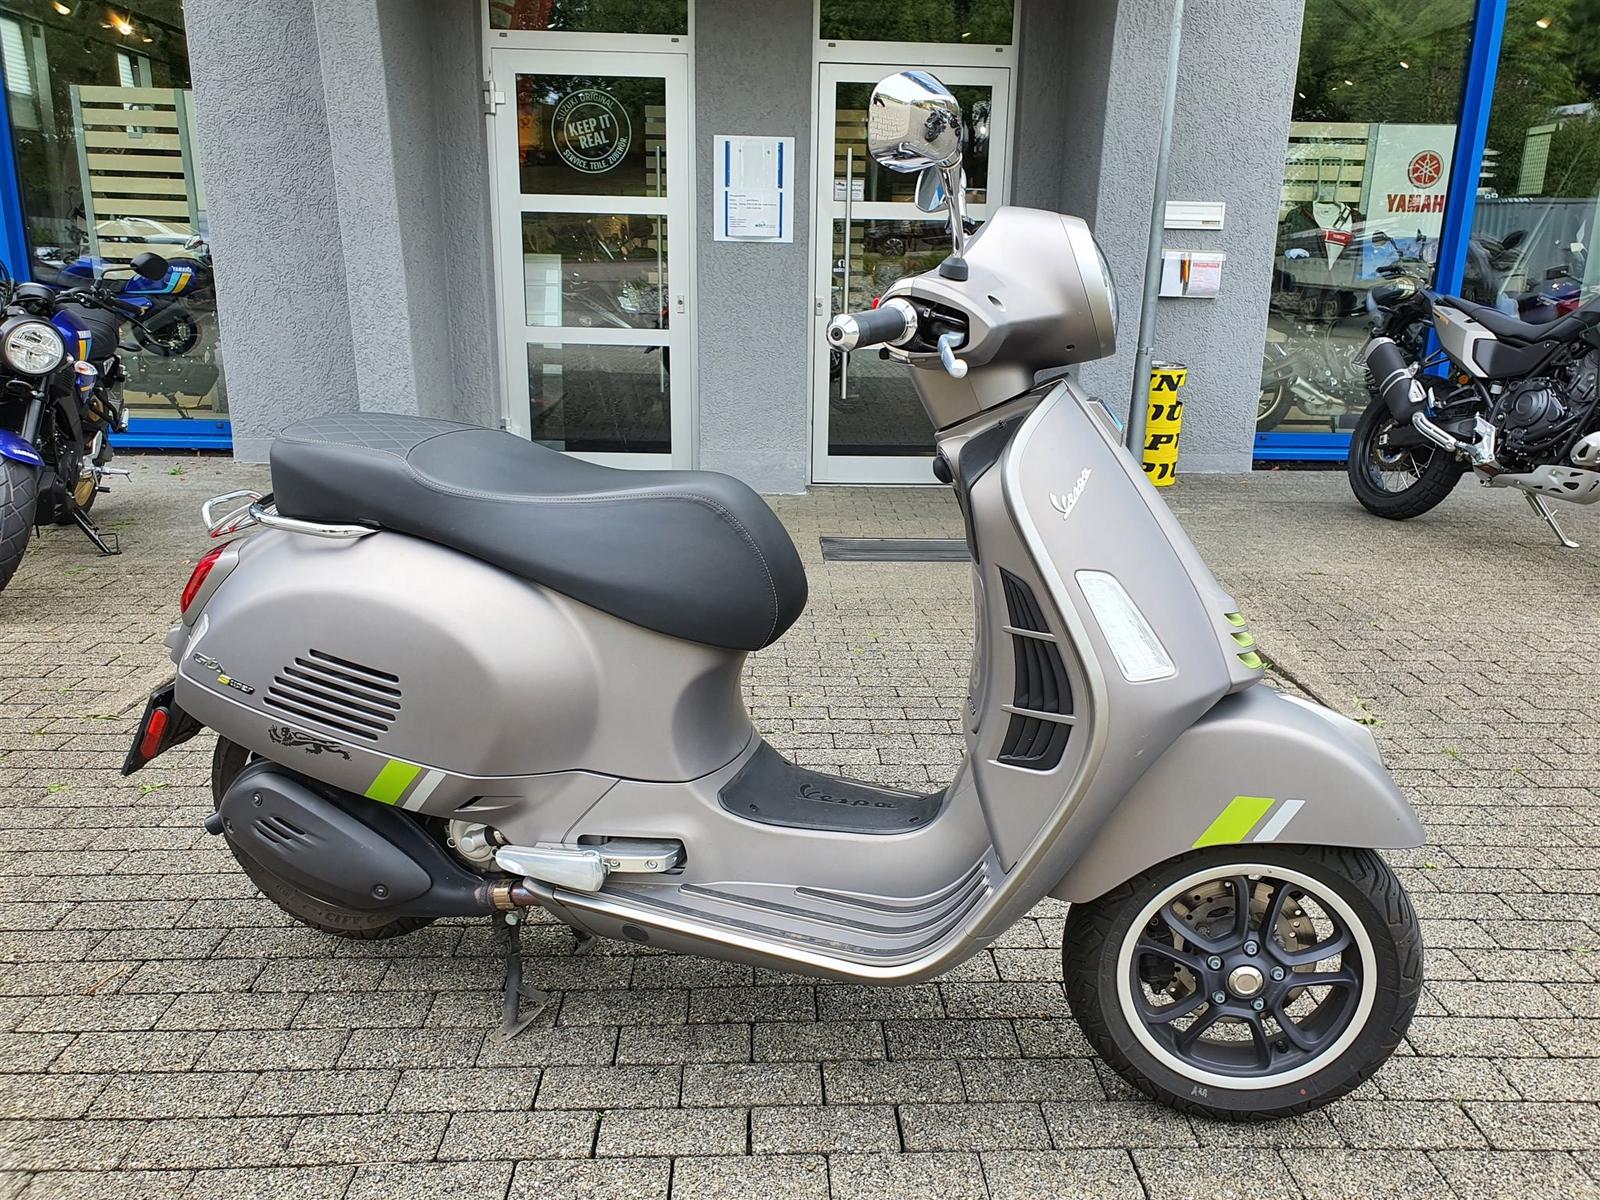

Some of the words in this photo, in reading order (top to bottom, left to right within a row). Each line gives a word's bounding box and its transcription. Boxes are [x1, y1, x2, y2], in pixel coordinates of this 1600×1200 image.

[557, 96, 579, 121] SUZUKI
[580, 92, 615, 110] ORIGINAL
[568, 118, 597, 136] KEEP
[599, 114, 611, 129] IT
[579, 130, 609, 149] REAL
[563, 149, 589, 169] SERVICE.
[590, 161, 609, 170] TEILE.
[1387, 193, 1445, 213] YAMAH
